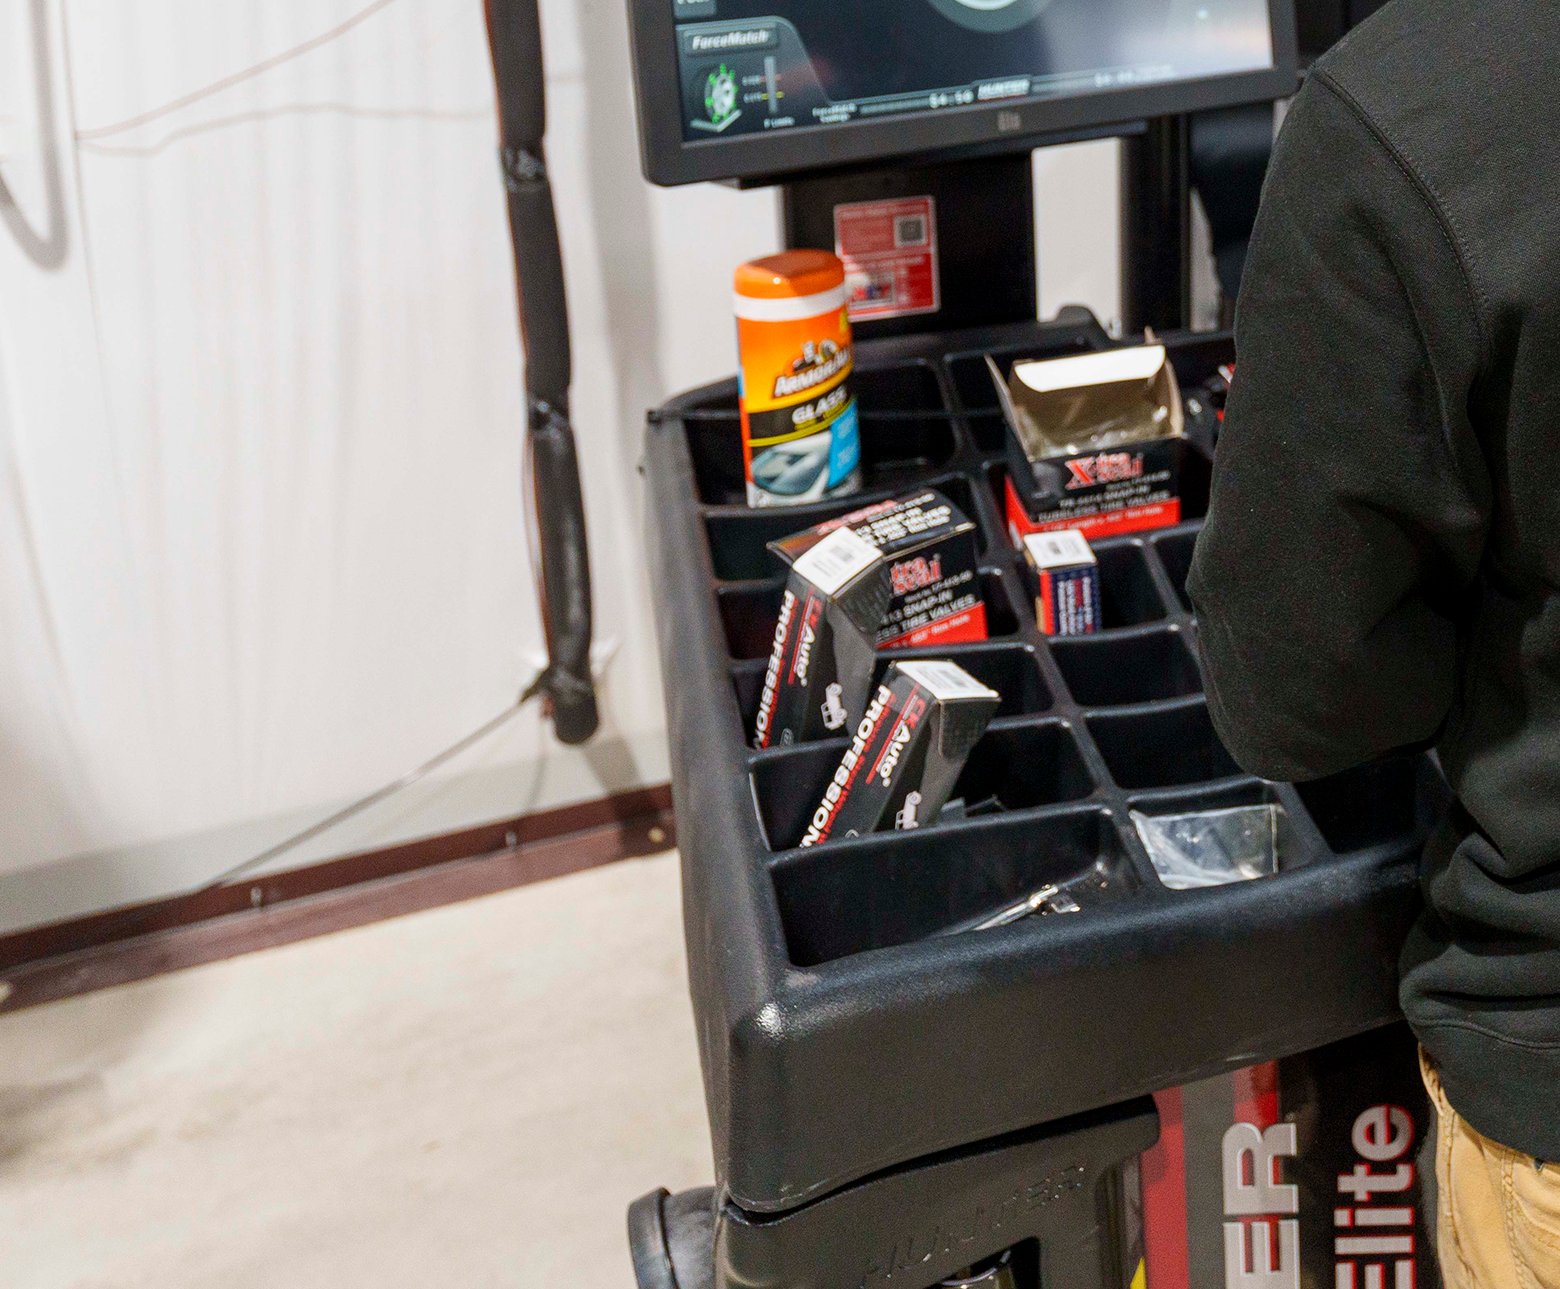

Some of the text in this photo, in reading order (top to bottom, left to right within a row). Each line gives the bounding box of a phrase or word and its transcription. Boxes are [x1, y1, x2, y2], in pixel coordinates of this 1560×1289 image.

[692, 29, 770, 50] ForceMatch
[791, 384, 847, 424] GLASS
[929, 593, 975, 620] VALVES
[1333, 1103, 1415, 1289] Elite
